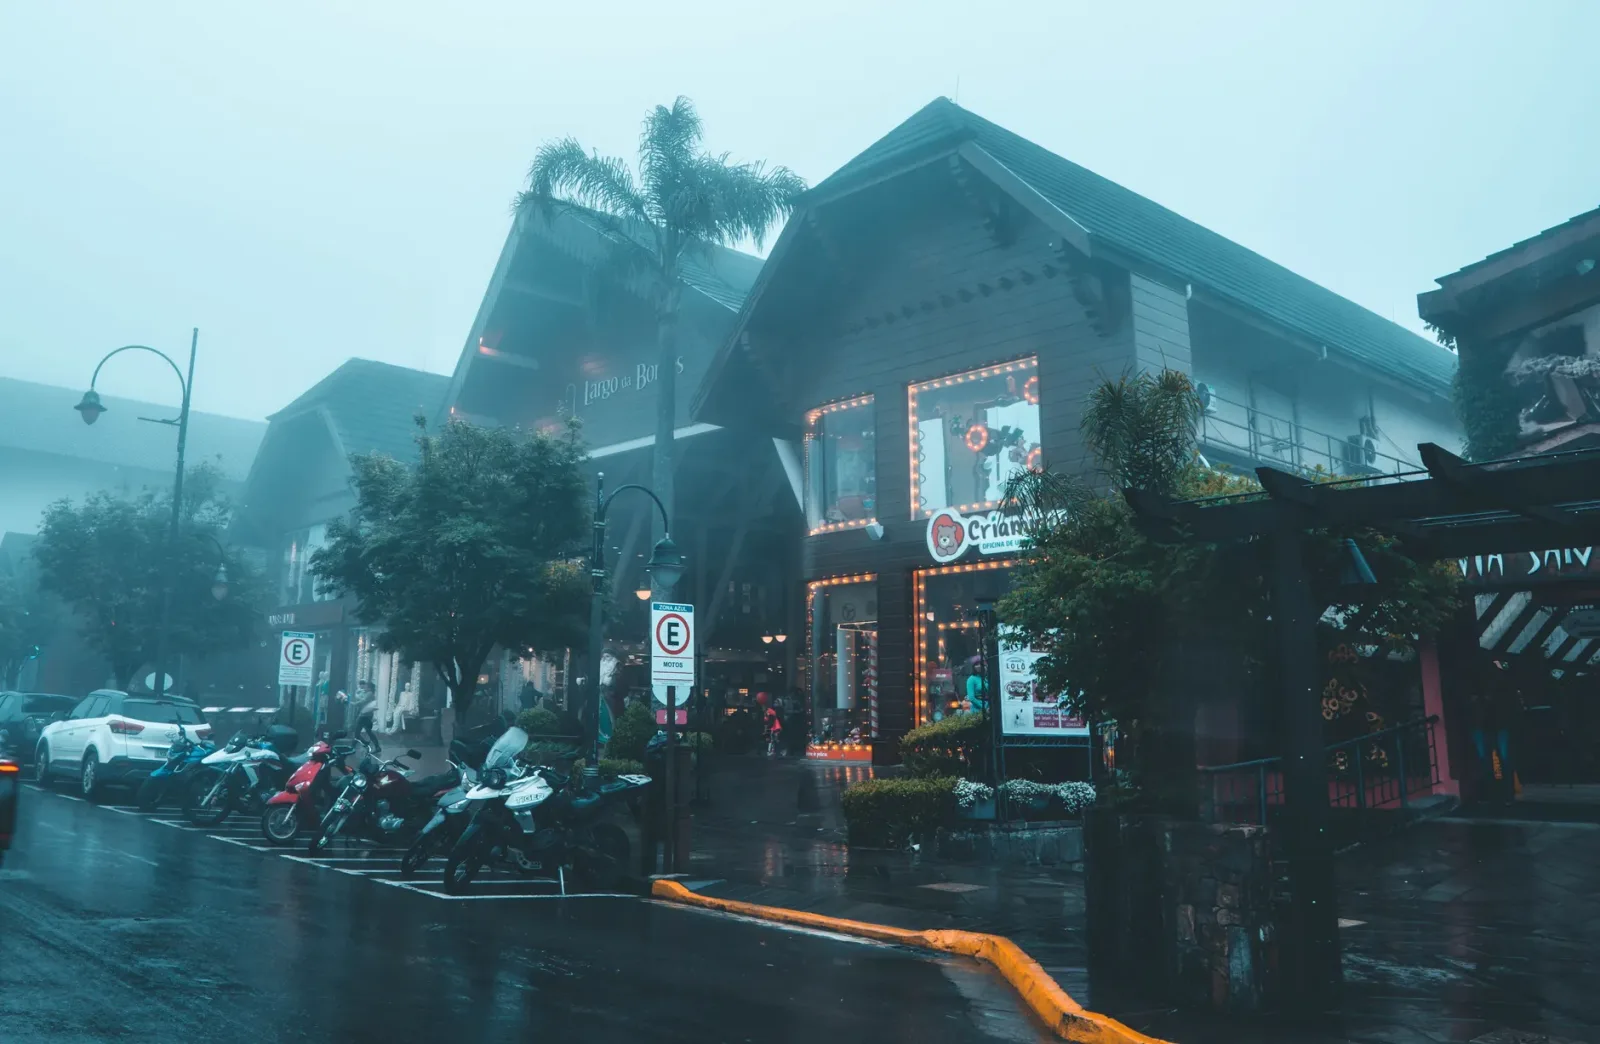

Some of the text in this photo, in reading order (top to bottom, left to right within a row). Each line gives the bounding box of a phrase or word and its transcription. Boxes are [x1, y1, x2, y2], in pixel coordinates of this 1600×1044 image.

[584, 355, 684, 406] Largo da Bors
[982, 540, 1005, 550] OFICINA
[667, 622, 680, 646] E
[292, 644, 303, 660] E
